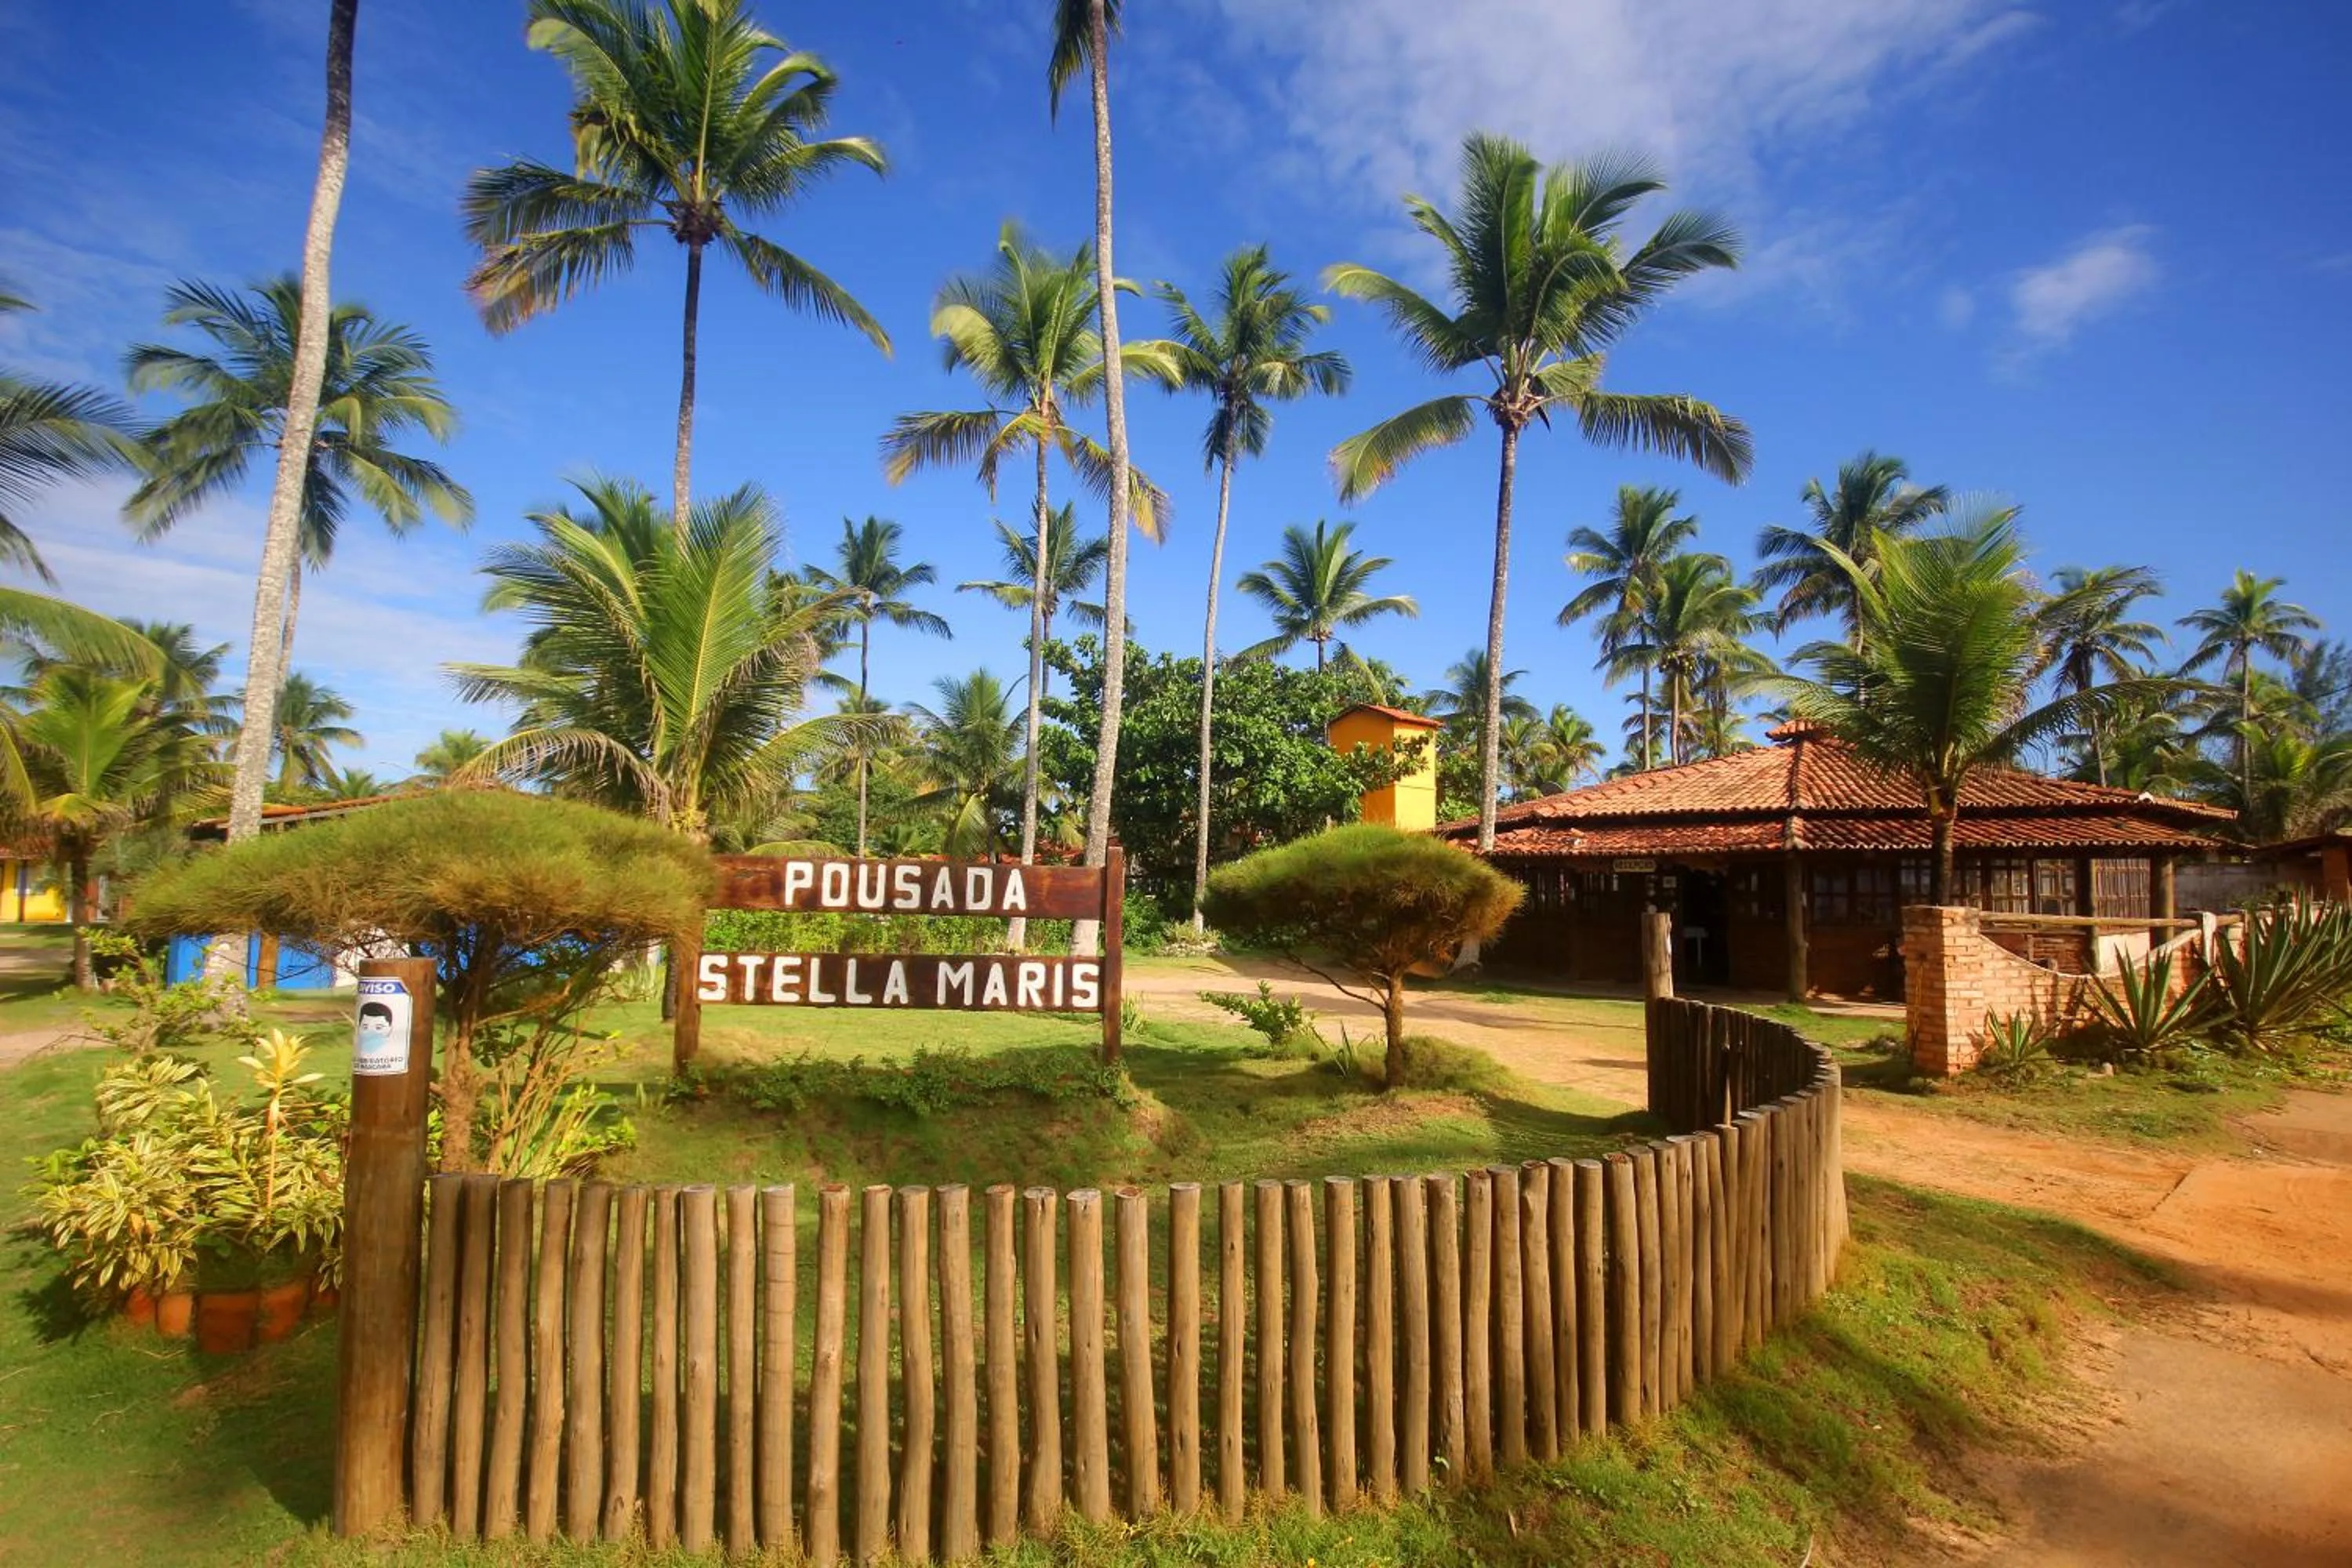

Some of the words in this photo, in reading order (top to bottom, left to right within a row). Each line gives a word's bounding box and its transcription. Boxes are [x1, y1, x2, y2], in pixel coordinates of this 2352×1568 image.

[785, 861, 1026, 911] POUSADA
[698, 954, 909, 1005] STELLA
[937, 961, 1099, 1007] MARIS
